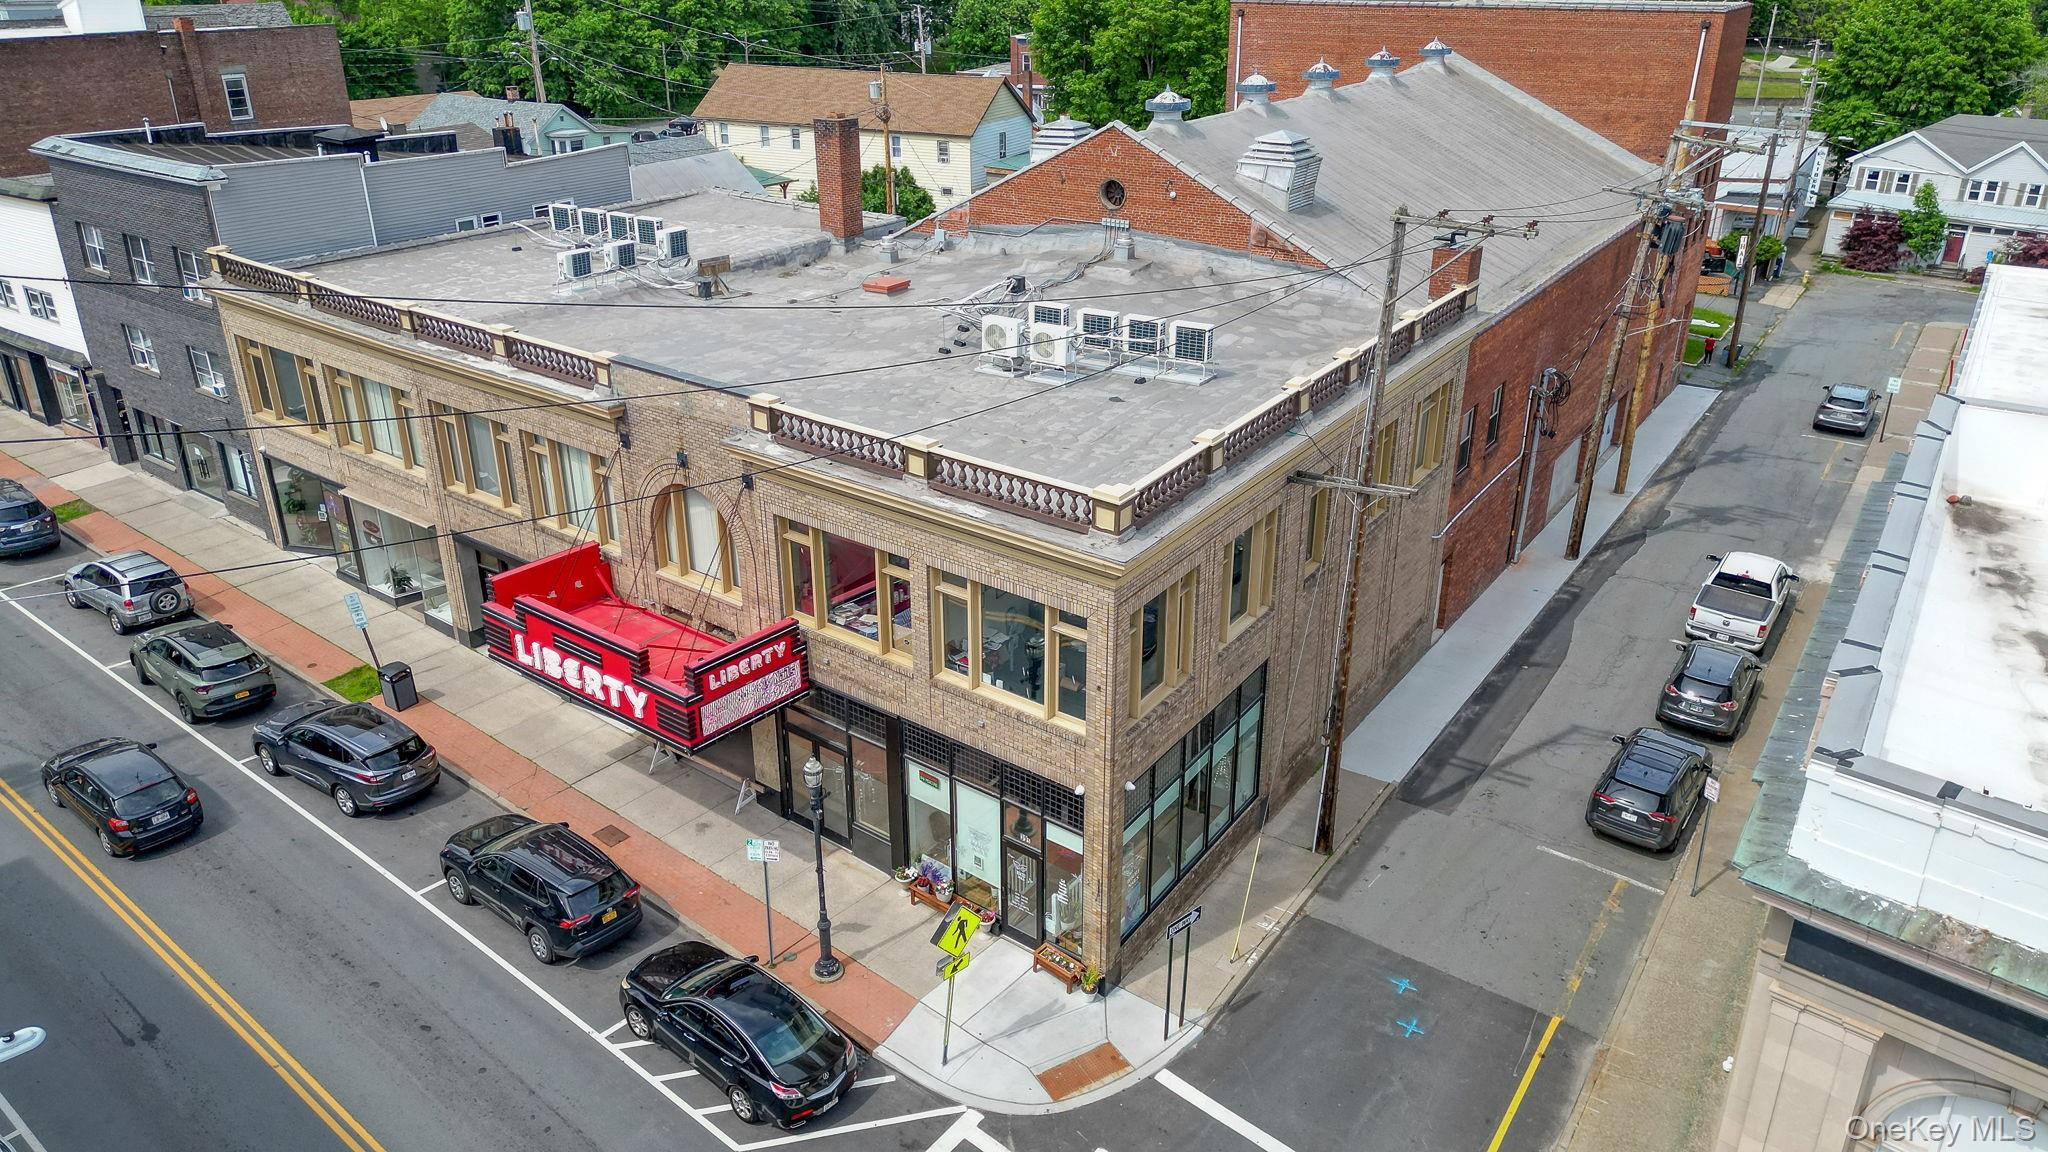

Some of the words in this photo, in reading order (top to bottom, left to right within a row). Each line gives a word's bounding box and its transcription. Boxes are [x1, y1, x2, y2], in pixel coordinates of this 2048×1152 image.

[1809, 161, 1821, 201] LIBERY
[514, 633, 648, 719] LIBERTY
[708, 641, 786, 691] LIBERTY
